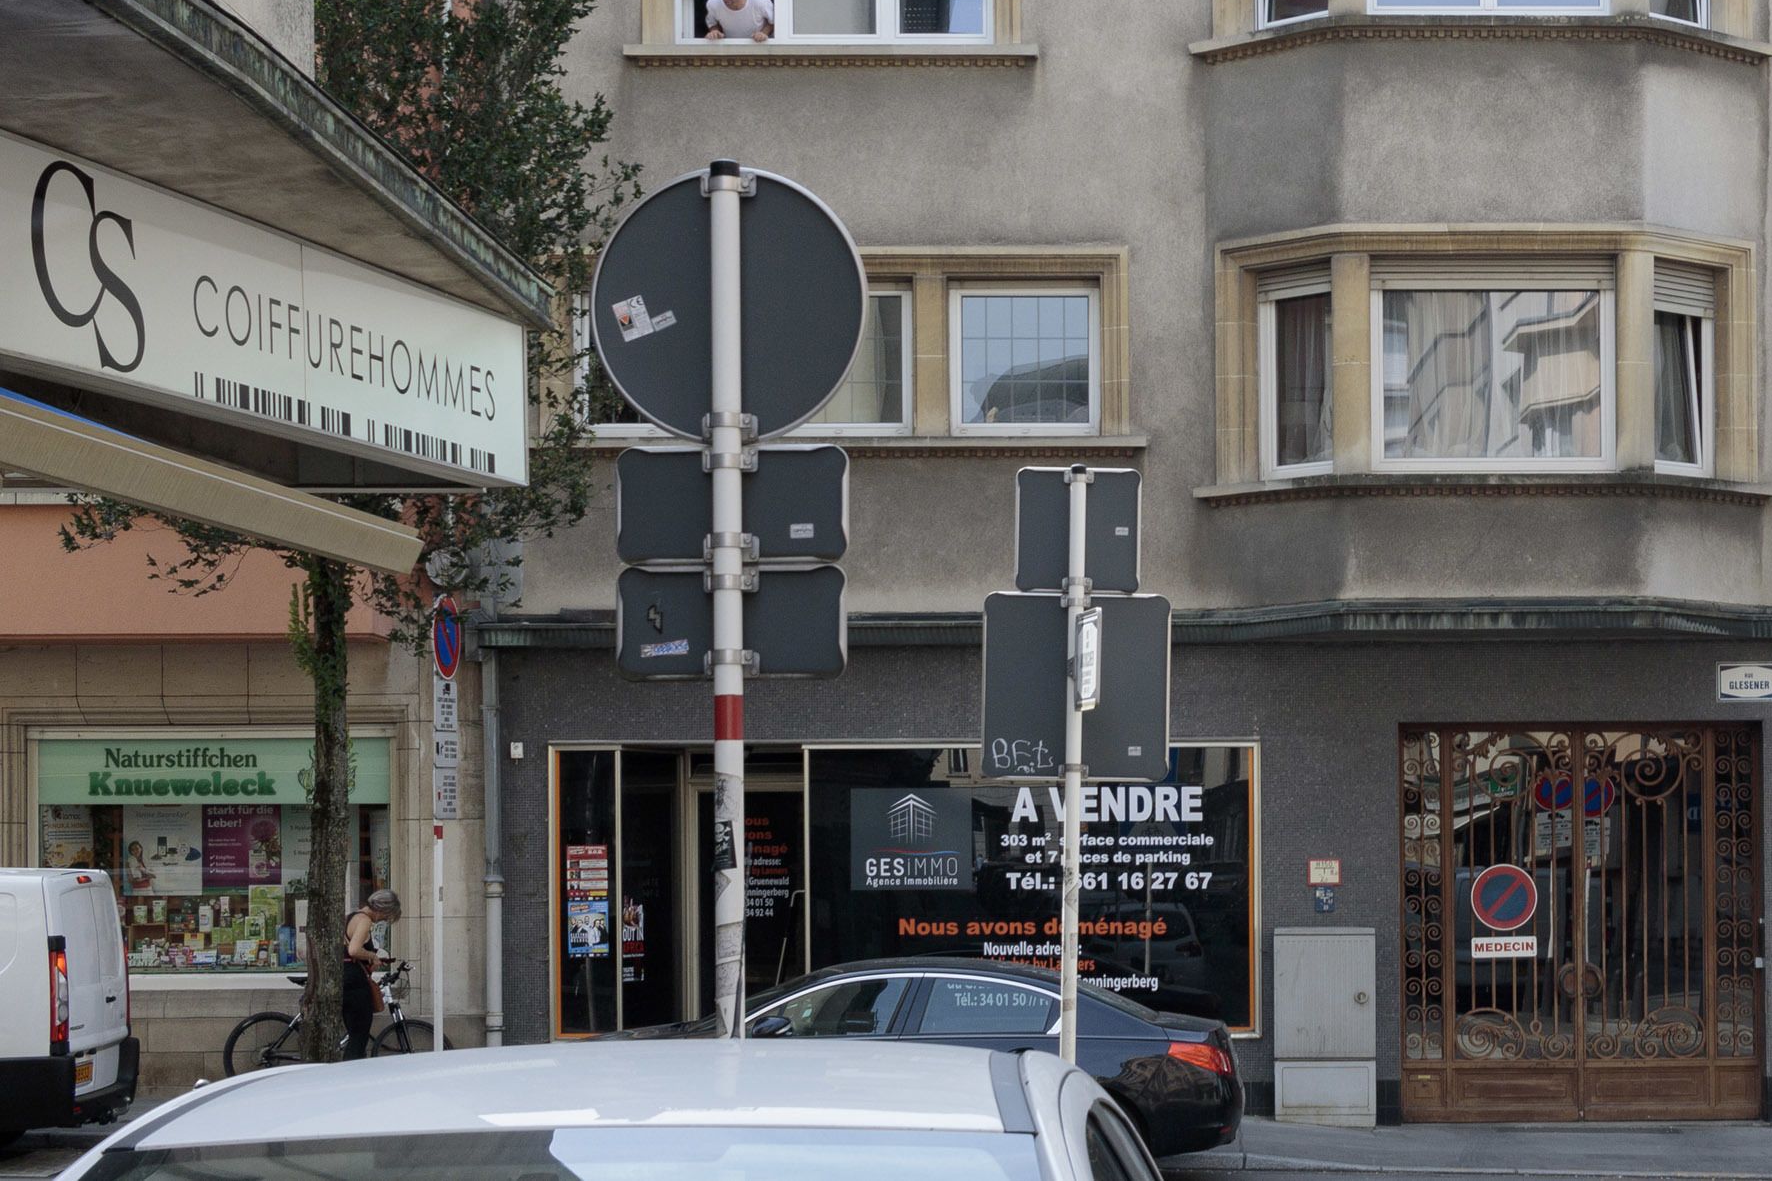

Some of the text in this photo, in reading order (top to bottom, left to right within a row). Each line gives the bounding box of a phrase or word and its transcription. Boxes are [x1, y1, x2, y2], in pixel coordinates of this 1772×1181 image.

[193, 275, 496, 422] COIFFUREHOMMES
[1729, 680, 1770, 690] GLESENER
[104, 747, 258, 768] Naturstiffchen
[88, 771, 277, 797] Knueweleck
[207, 805, 235, 816] stark
[257, 805, 274, 816] die
[1012, 786, 1039, 823] A
[207, 818, 242, 828] Leber!
[1001, 834, 1028, 846] 303
[1031, 832, 1052, 846] m²
[1118, 833, 1214, 847] commerciale
[1025, 852, 1042, 864] et
[1047, 851, 1058, 864] 7
[1112, 851, 1131, 864] de
[1135, 851, 1191, 866] parking
[865, 876, 958, 888] Agence Immobilière
[1005, 871, 1056, 890] Tél.:
[1118, 872, 1145, 890] 16
[1151, 872, 1179, 890] 27
[1184, 872, 1213, 890] 67
[899, 917, 960, 936] Nous
[966, 920, 1037, 936] avons
[983, 940, 1034, 956] Nouvelle
[1474, 941, 1535, 953] MEDECIN
[980, 993, 993, 1006] 34
[995, 993, 1009, 1006] 01
[1012, 993, 1026, 1006] 50
